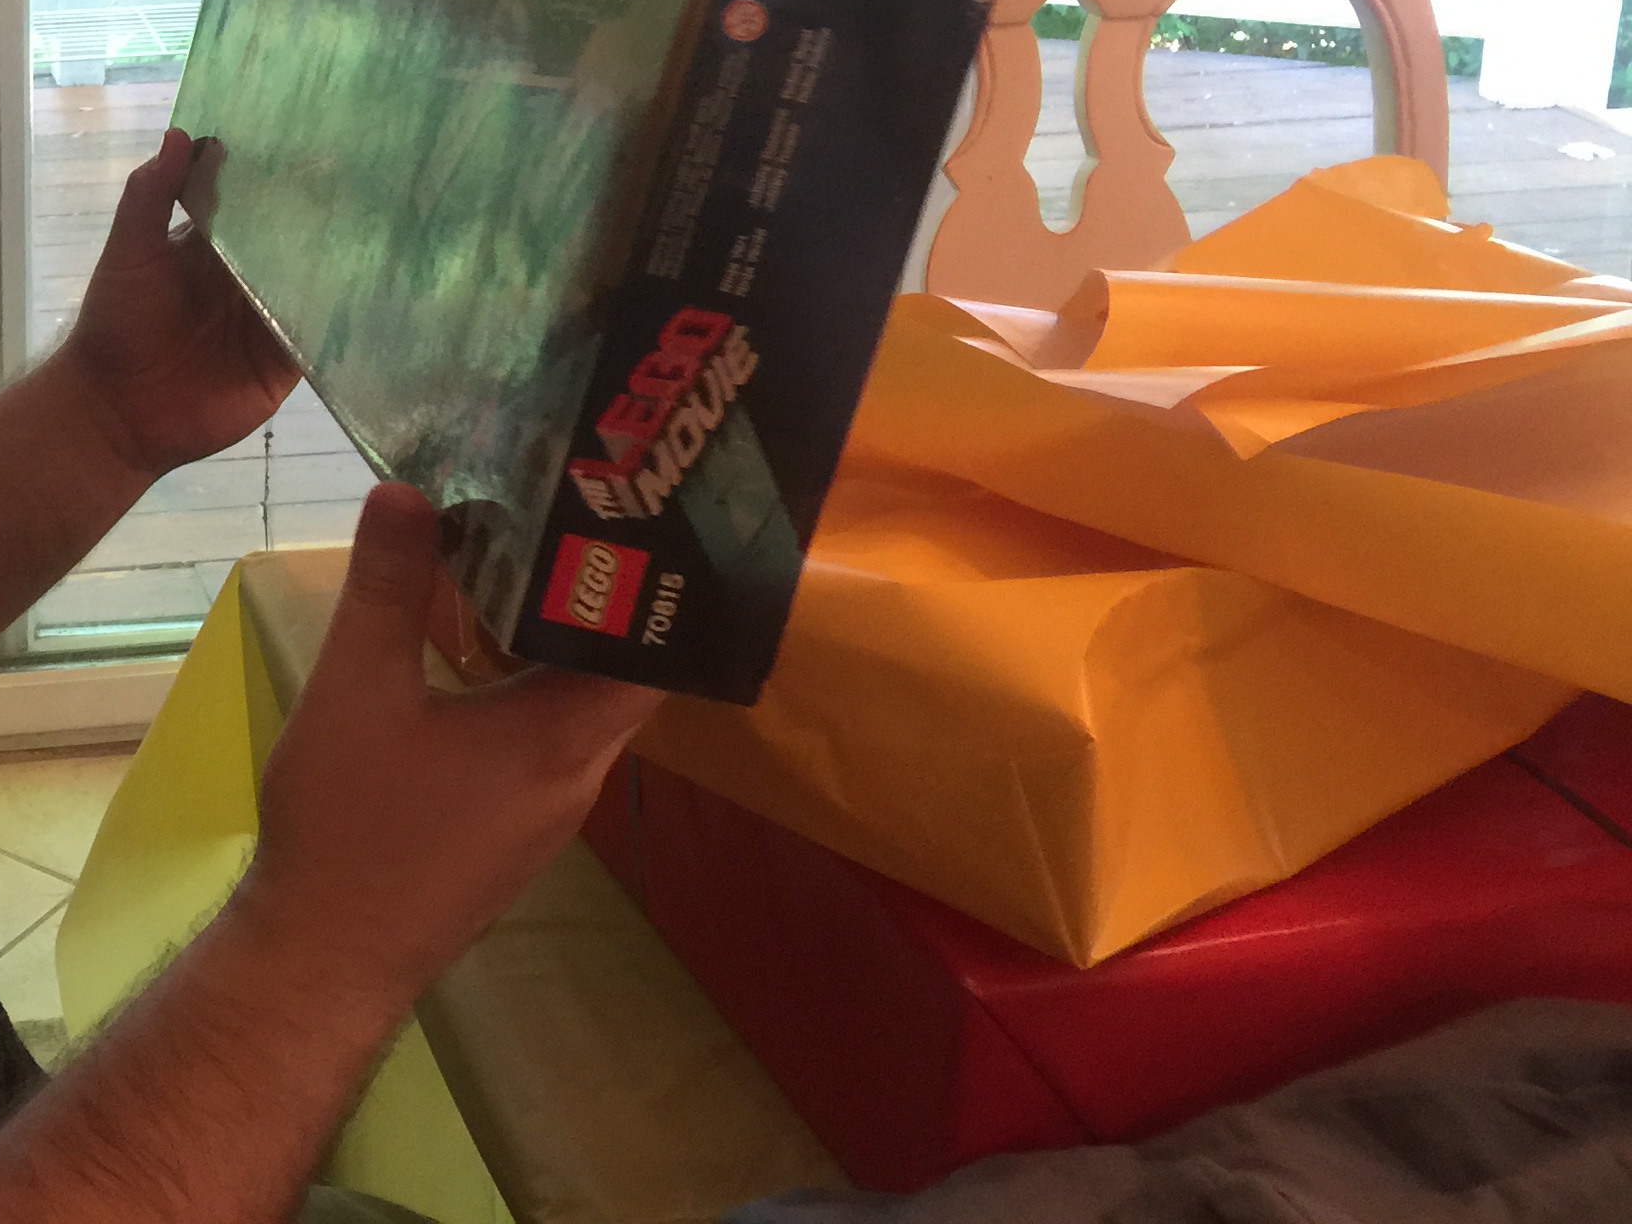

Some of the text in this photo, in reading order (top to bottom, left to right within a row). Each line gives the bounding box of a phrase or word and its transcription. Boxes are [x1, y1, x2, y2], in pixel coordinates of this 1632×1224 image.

[566, 307, 733, 482] LEGO
[634, 325, 760, 518] MOVIE
[570, 543, 620, 629] LEGO
